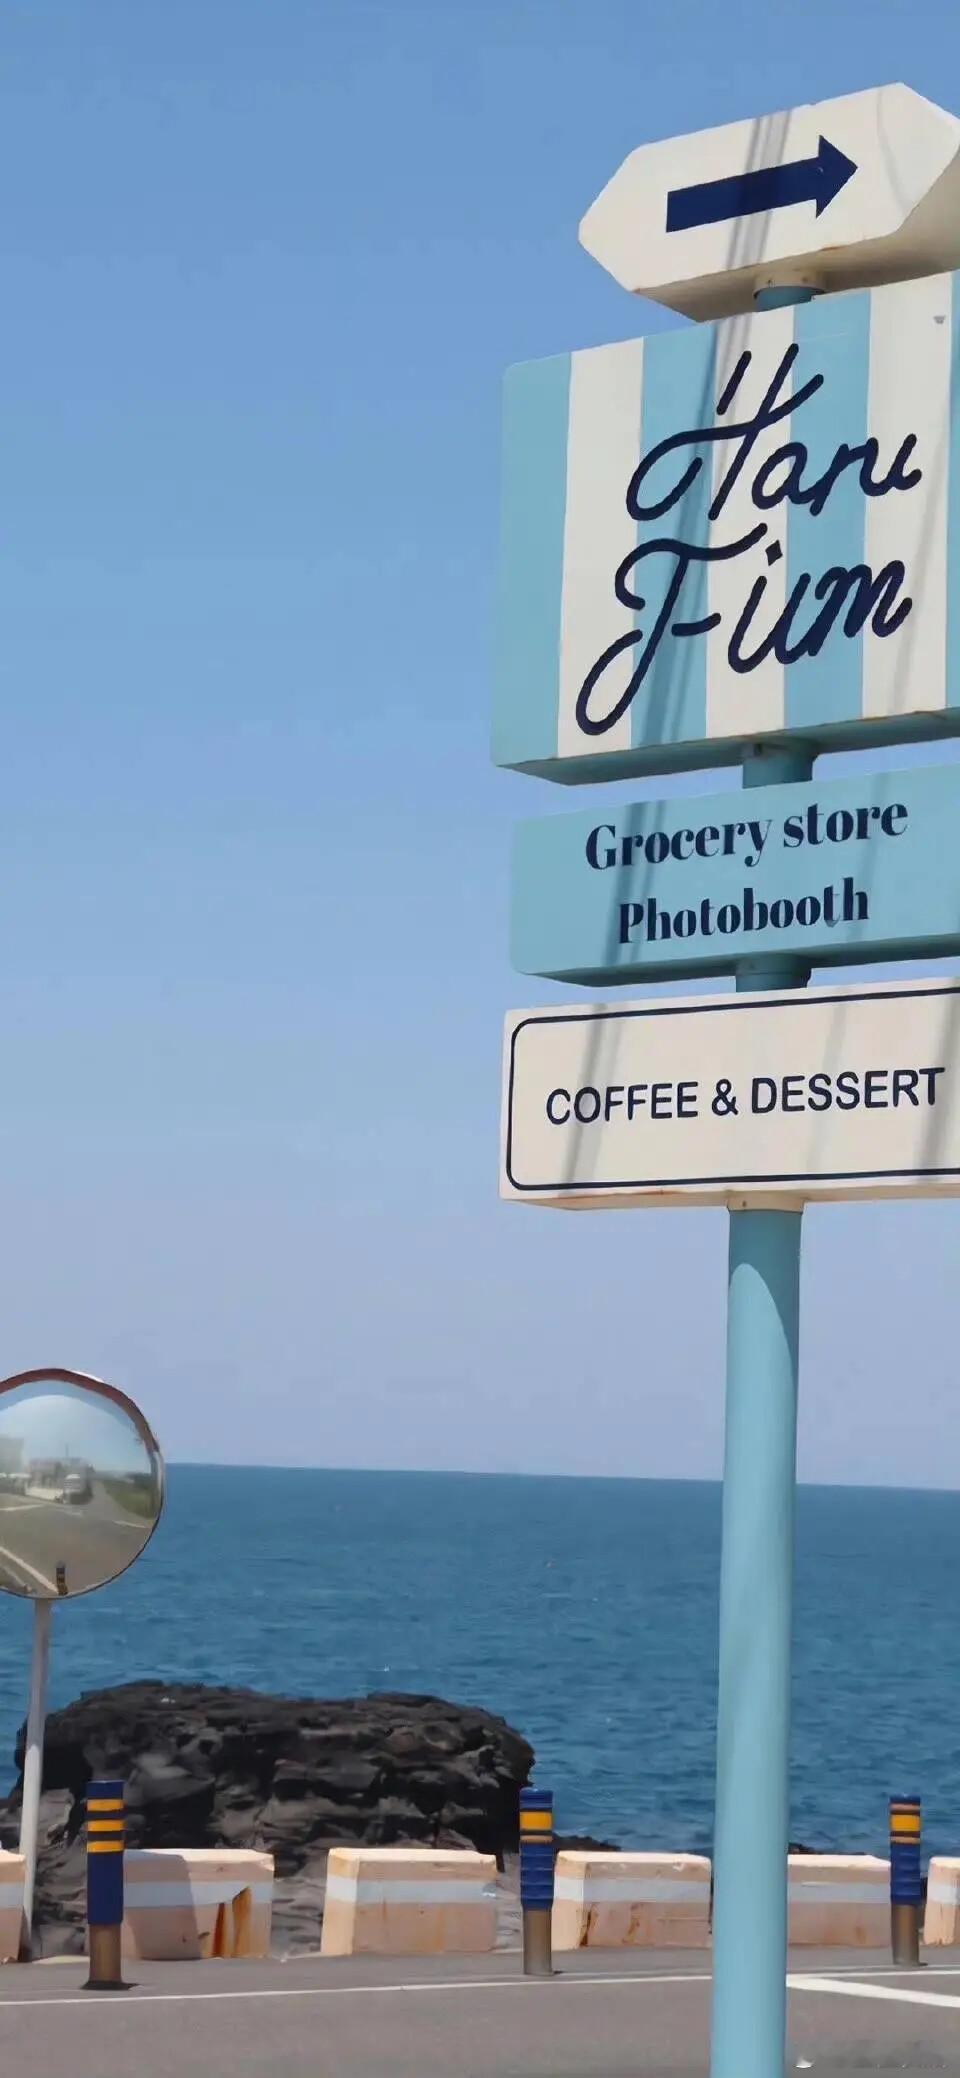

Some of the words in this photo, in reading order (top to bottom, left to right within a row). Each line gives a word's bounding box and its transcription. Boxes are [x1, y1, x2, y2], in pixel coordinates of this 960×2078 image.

[626, 343, 922, 521] Haru
[585, 818, 772, 870] Grocery
[783, 802, 908, 848] store
[618, 877, 869, 944] Photobooth
[546, 1081, 698, 1125] COFFEE
[711, 1078, 739, 1116] &
[751, 1067, 945, 1114] DESSERT
